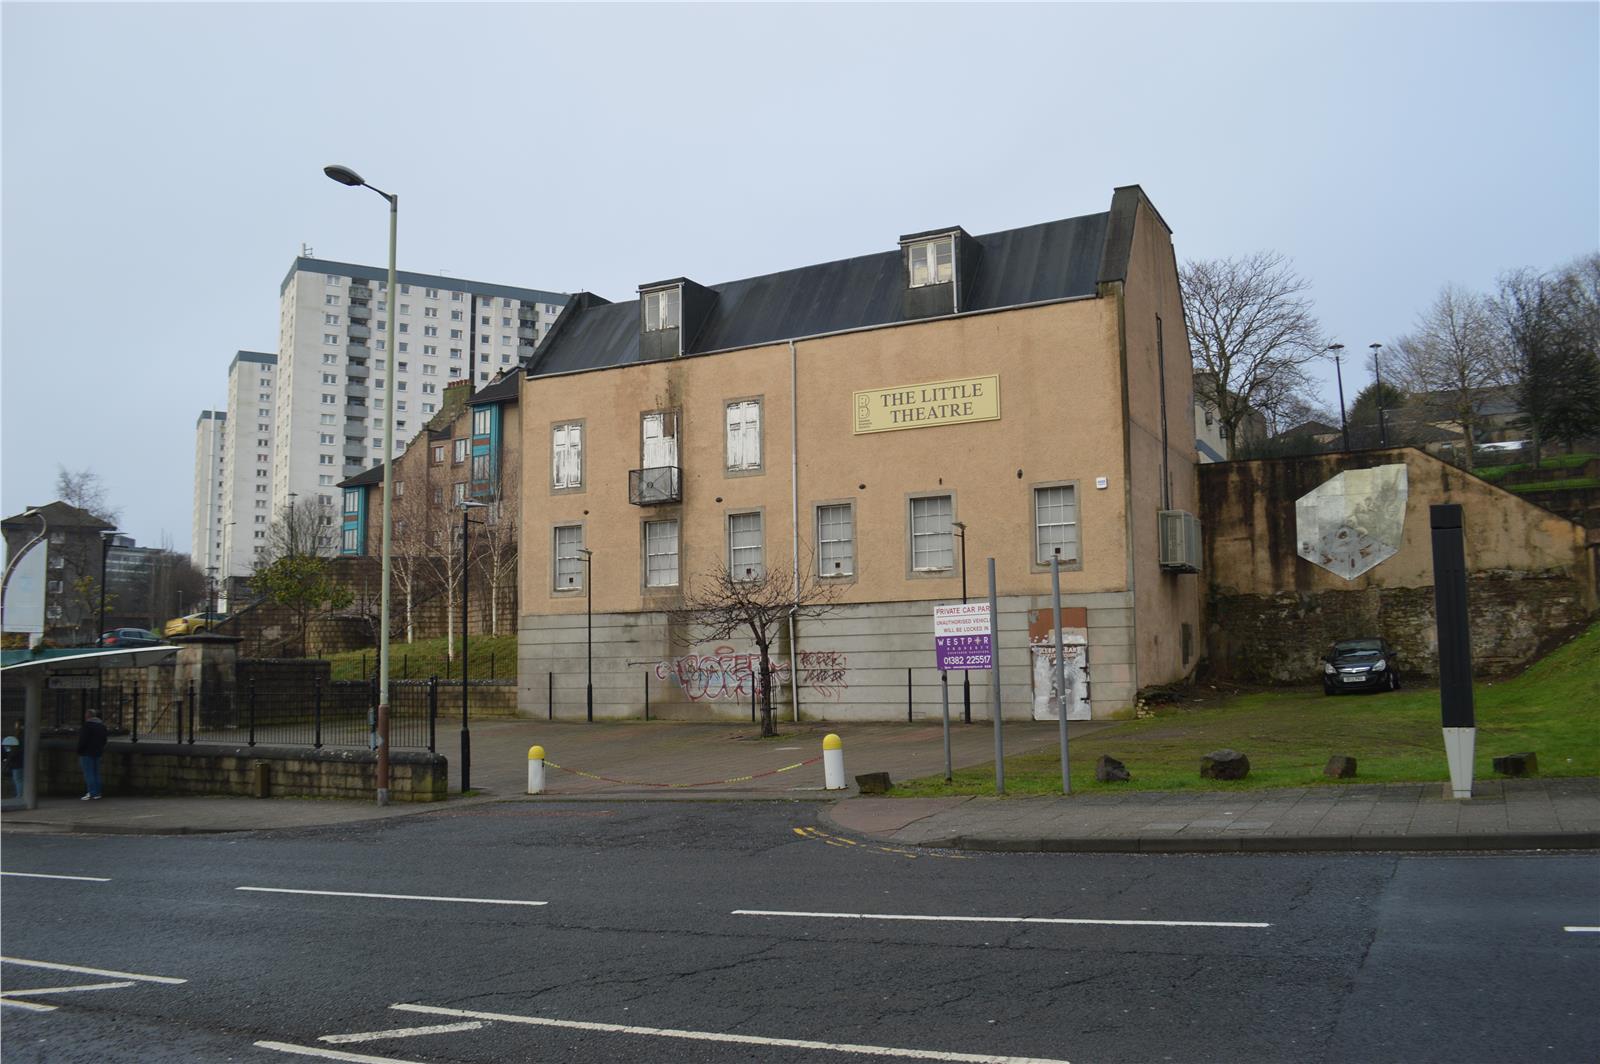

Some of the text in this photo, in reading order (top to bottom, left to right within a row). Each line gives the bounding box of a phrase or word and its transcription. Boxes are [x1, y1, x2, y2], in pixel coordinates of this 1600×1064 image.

[880, 383, 984, 408] THE LITTLE
[890, 402, 974, 424] THEATRE
[936, 607, 961, 616] PRIVATE
[962, 606, 976, 614] CAR
[936, 618, 972, 626] UNAUTHORISED
[944, 655, 991, 665] 01382 225517
